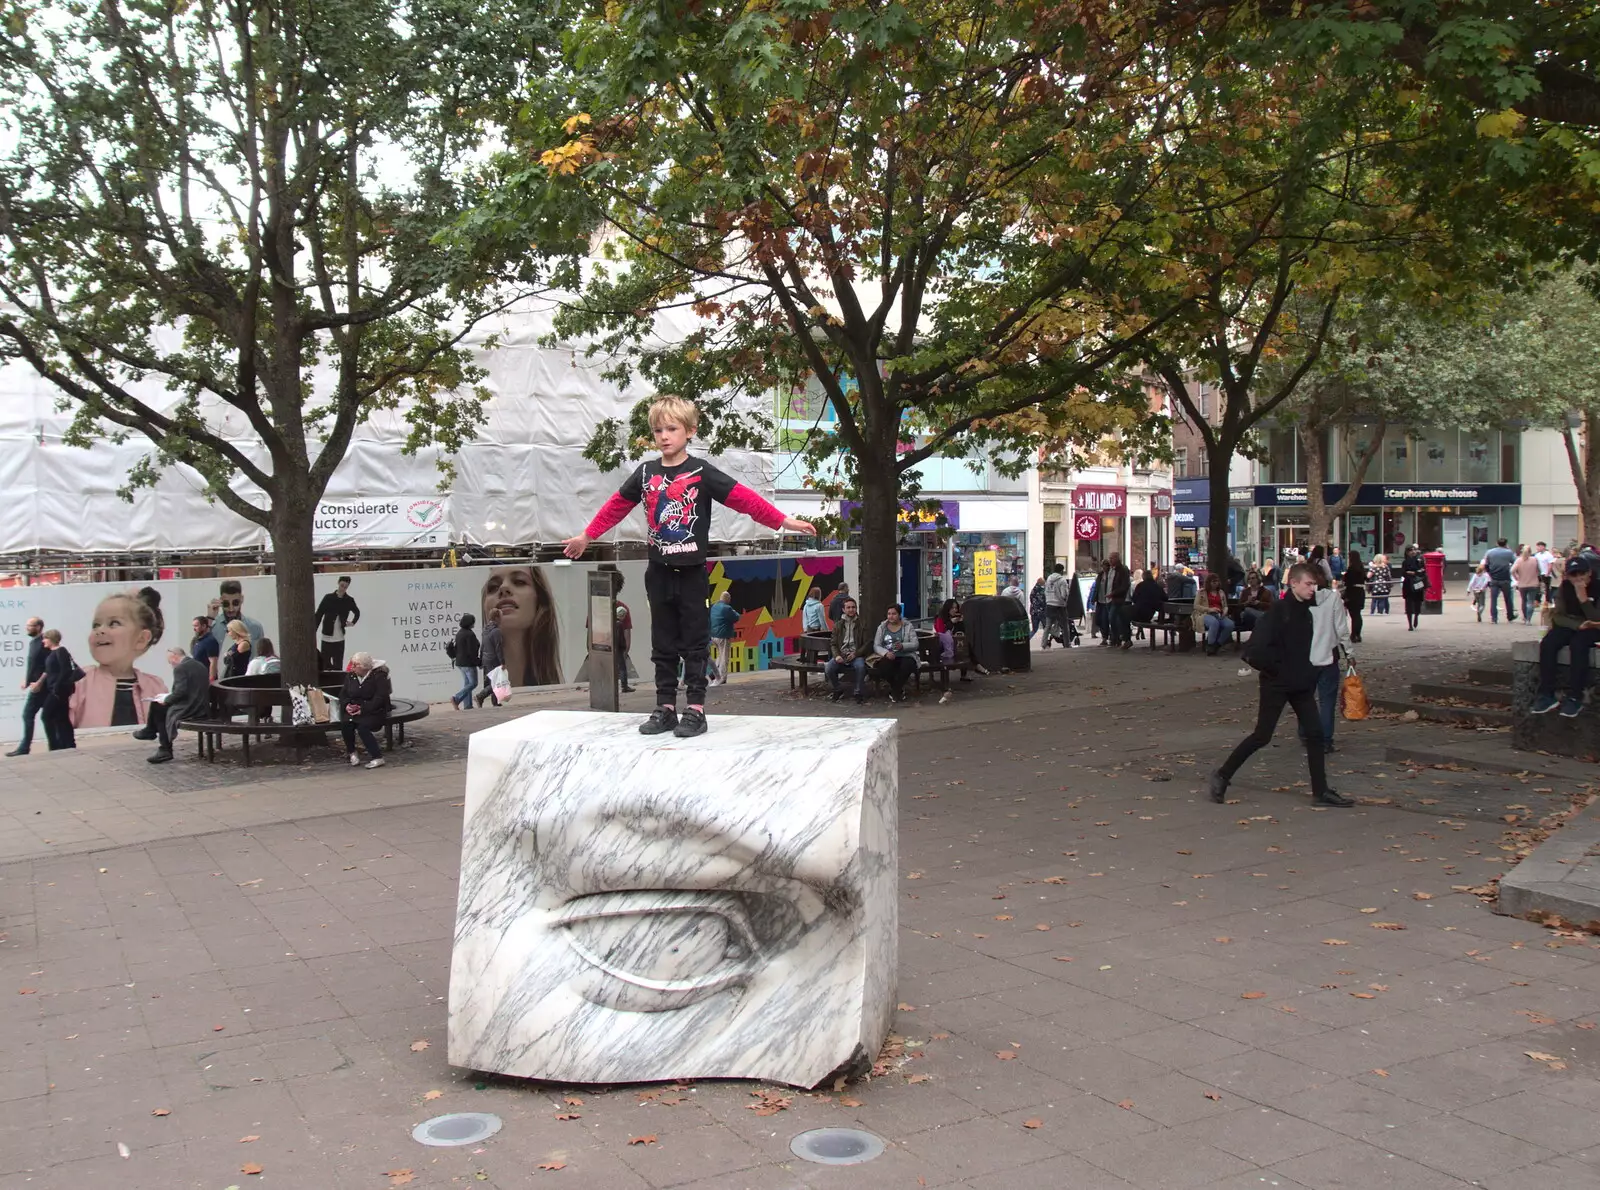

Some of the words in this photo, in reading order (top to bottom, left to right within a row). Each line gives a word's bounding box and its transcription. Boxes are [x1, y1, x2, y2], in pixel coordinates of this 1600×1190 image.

[1388, 489, 1429, 499] Carphone
[1430, 489, 1478, 498] Warehouse
[320, 502, 398, 515] considerate
[407, 582, 454, 591] PRIMARK
[408, 600, 453, 611] WATCH
[392, 615, 421, 626] THIS
[428, 613, 468, 624] SPAC
[0, 641, 24, 652] ED
